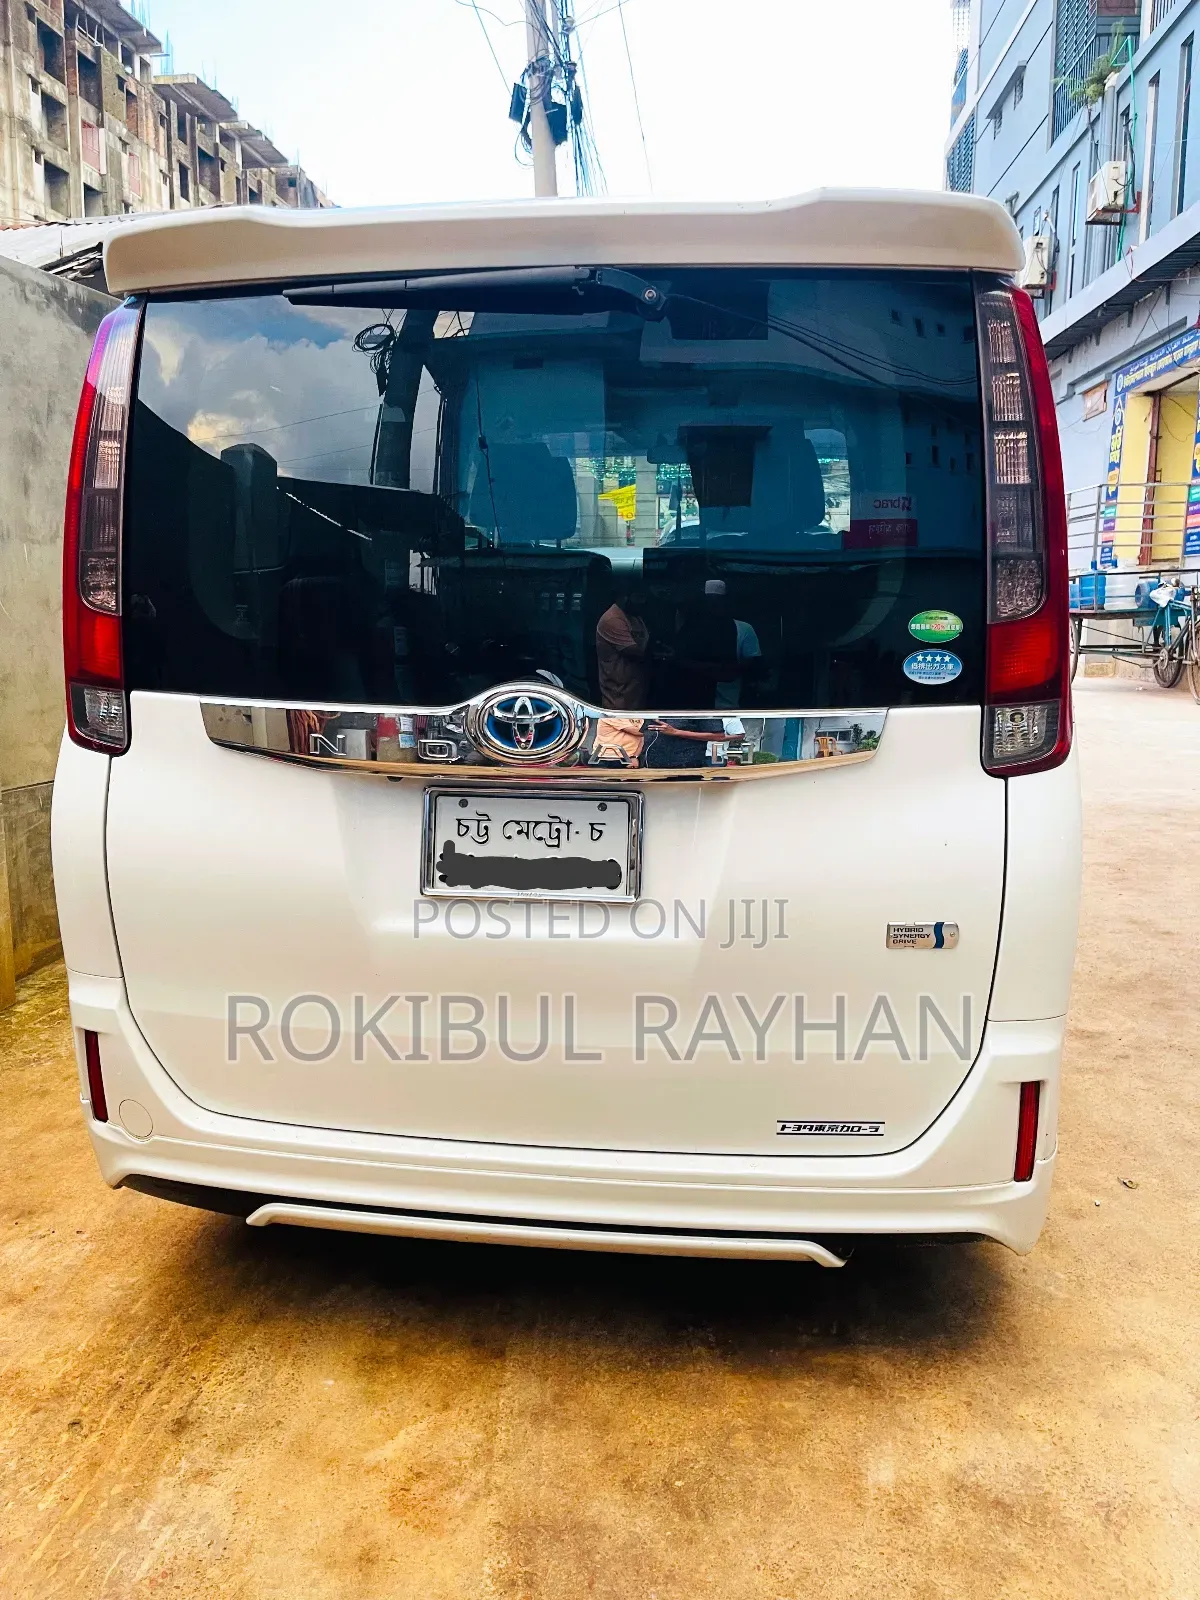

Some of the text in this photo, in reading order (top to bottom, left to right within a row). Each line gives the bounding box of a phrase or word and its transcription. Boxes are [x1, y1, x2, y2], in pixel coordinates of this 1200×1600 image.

[780, 1124, 881, 1133] トヨタ東京カローラ
